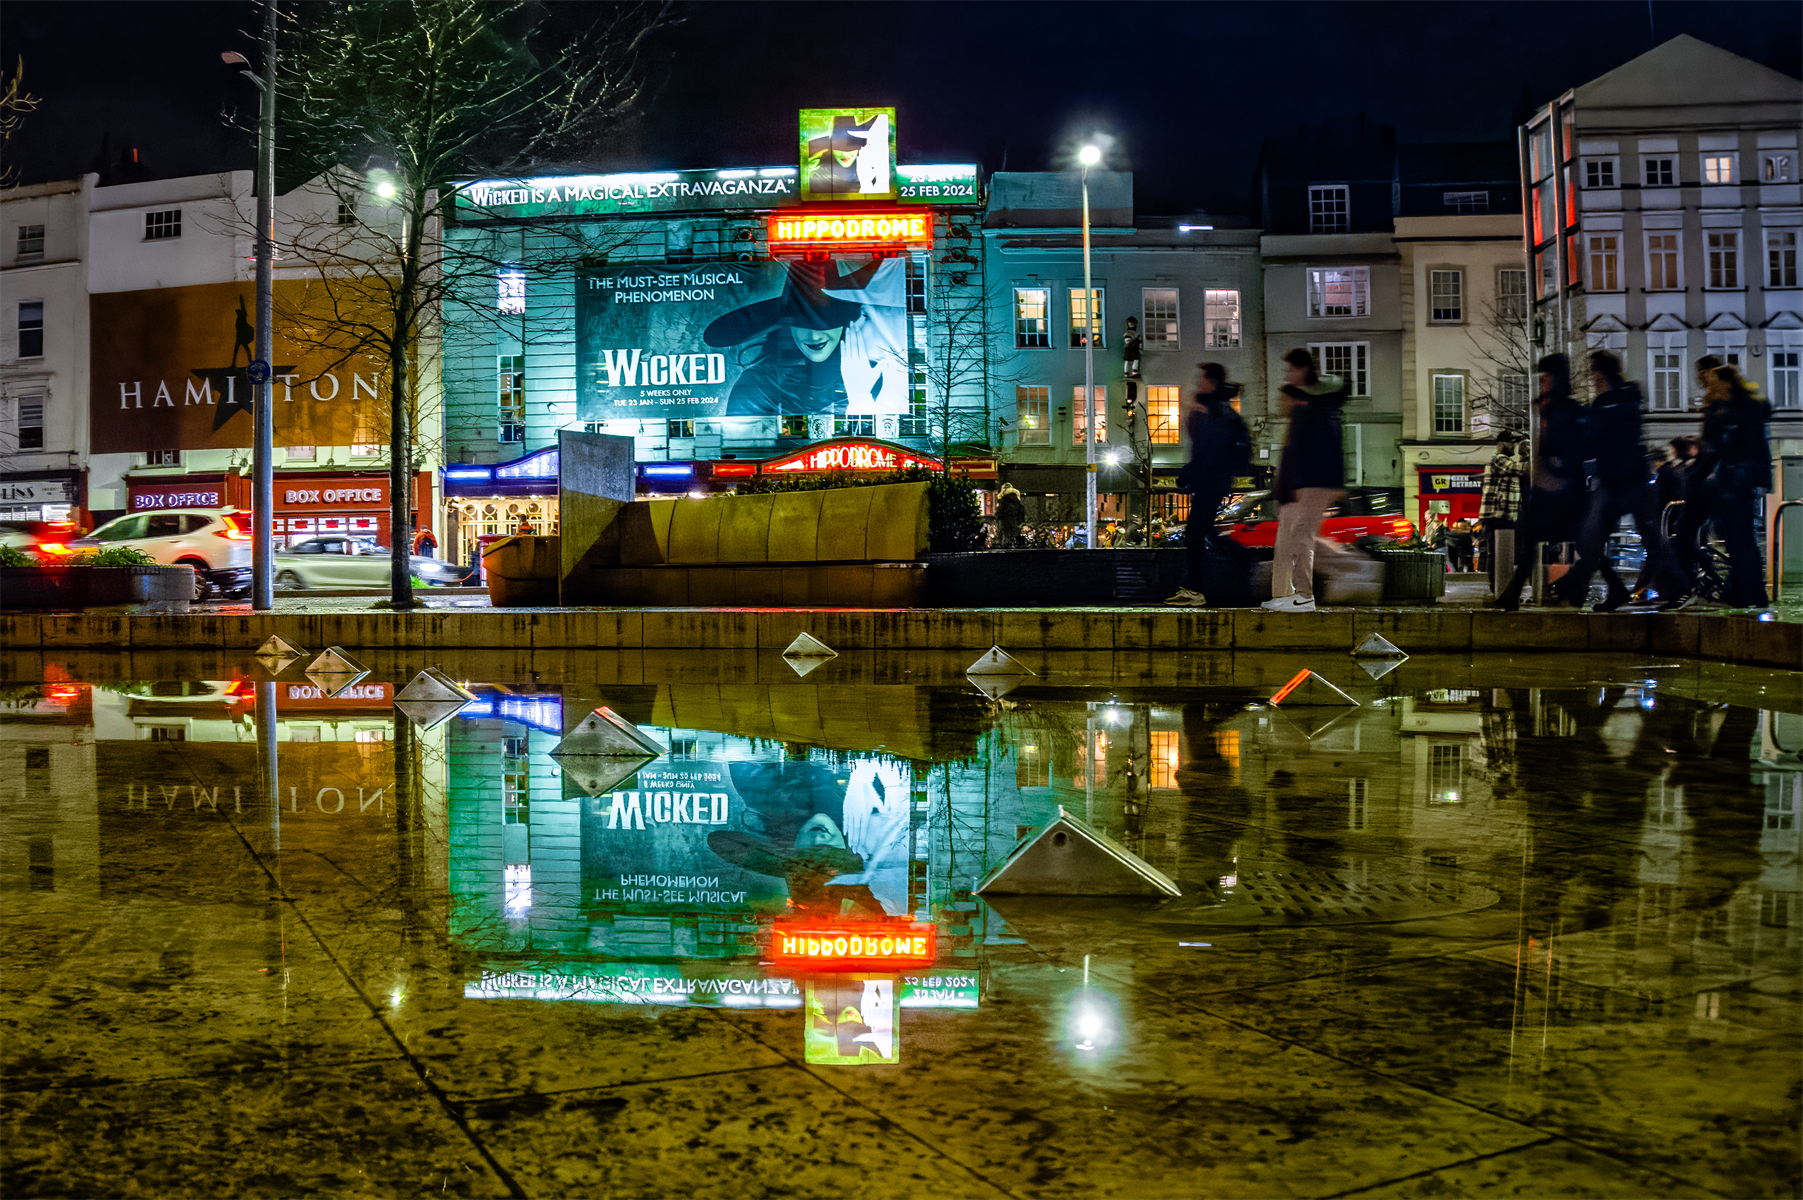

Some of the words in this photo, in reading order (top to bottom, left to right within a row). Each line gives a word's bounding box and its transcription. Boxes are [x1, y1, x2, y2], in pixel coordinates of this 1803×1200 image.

[531, 188, 546, 203] IS
[548, 186, 562, 203] A
[564, 183, 643, 201] MAGICAL
[900, 185, 916, 197] 25
[919, 185, 940, 197] FEB
[942, 184, 974, 196] 2024
[778, 219, 924, 239] HIPPODROME
[589, 277, 614, 290] THE
[616, 274, 680, 289] MUST-SEE
[683, 272, 744, 286] MUSICAL
[614, 289, 715, 304] PHENOMENON
[118, 372, 382, 409] HAMITON
[646, 389, 671, 397] WEEKS
[687, 397, 700, 405] FEB
[810, 446, 897, 468] HIPPODROME
[135, 494, 164, 508] BOX
[168, 491, 219, 506] OFFICE
[285, 489, 319, 503] BOX
[322, 488, 382, 502] OFFICE
